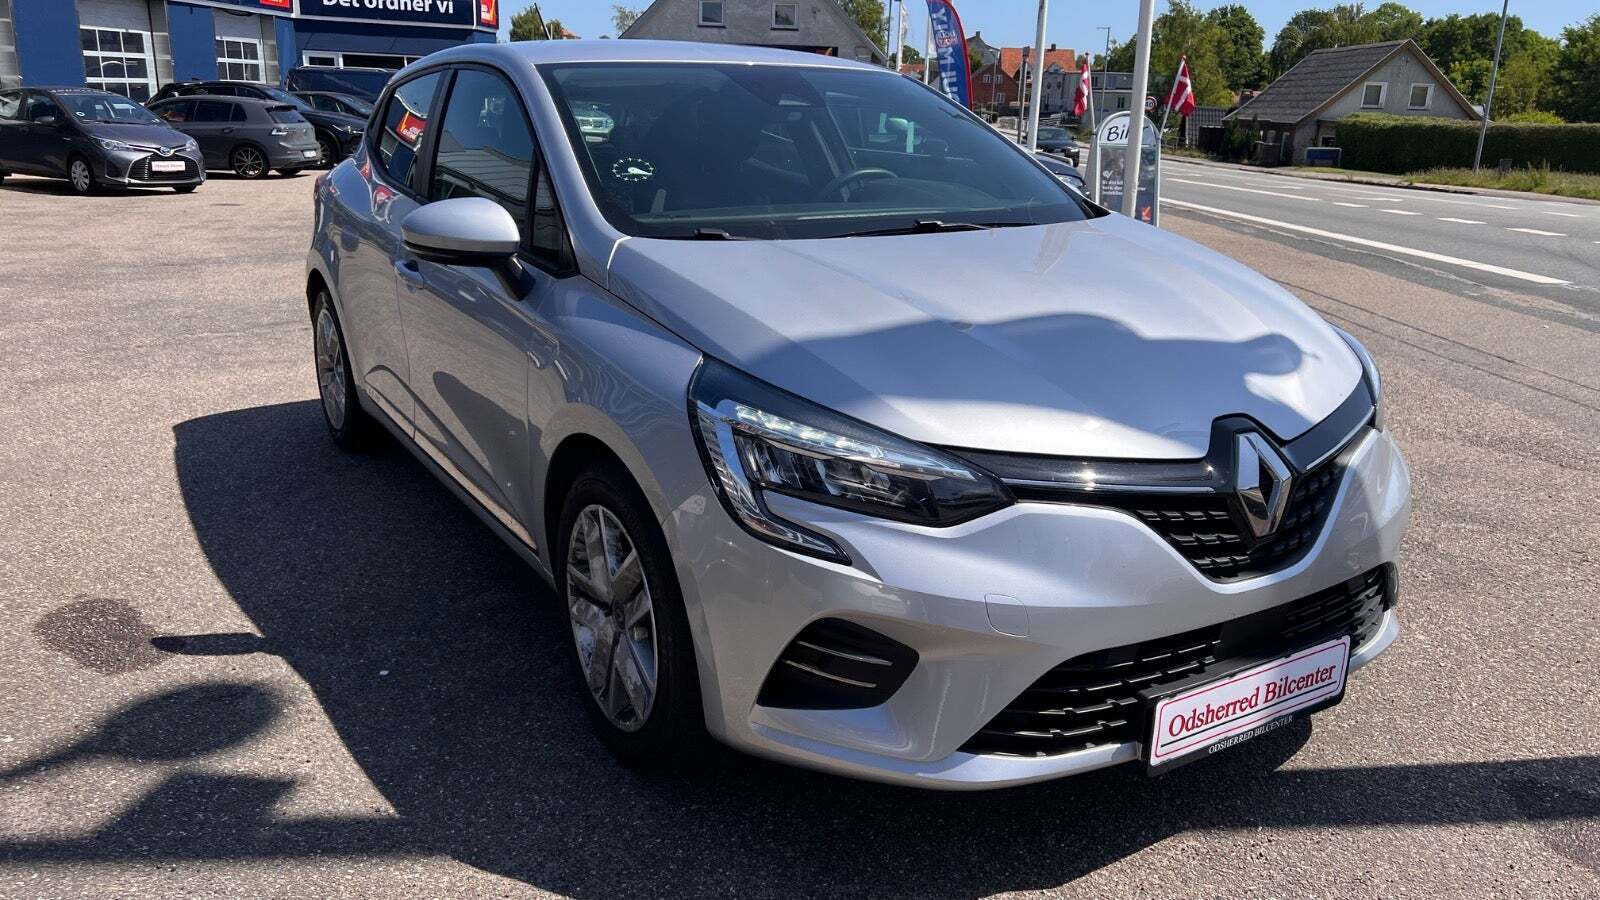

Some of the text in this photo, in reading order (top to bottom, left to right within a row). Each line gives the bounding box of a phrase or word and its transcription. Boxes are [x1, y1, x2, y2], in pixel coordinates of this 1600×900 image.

[436, 0, 454, 14] vi
[1169, 665, 1336, 737] Odsherred Bilcenter
[1208, 715, 1293, 754] ODSHERRED BILCENTER
